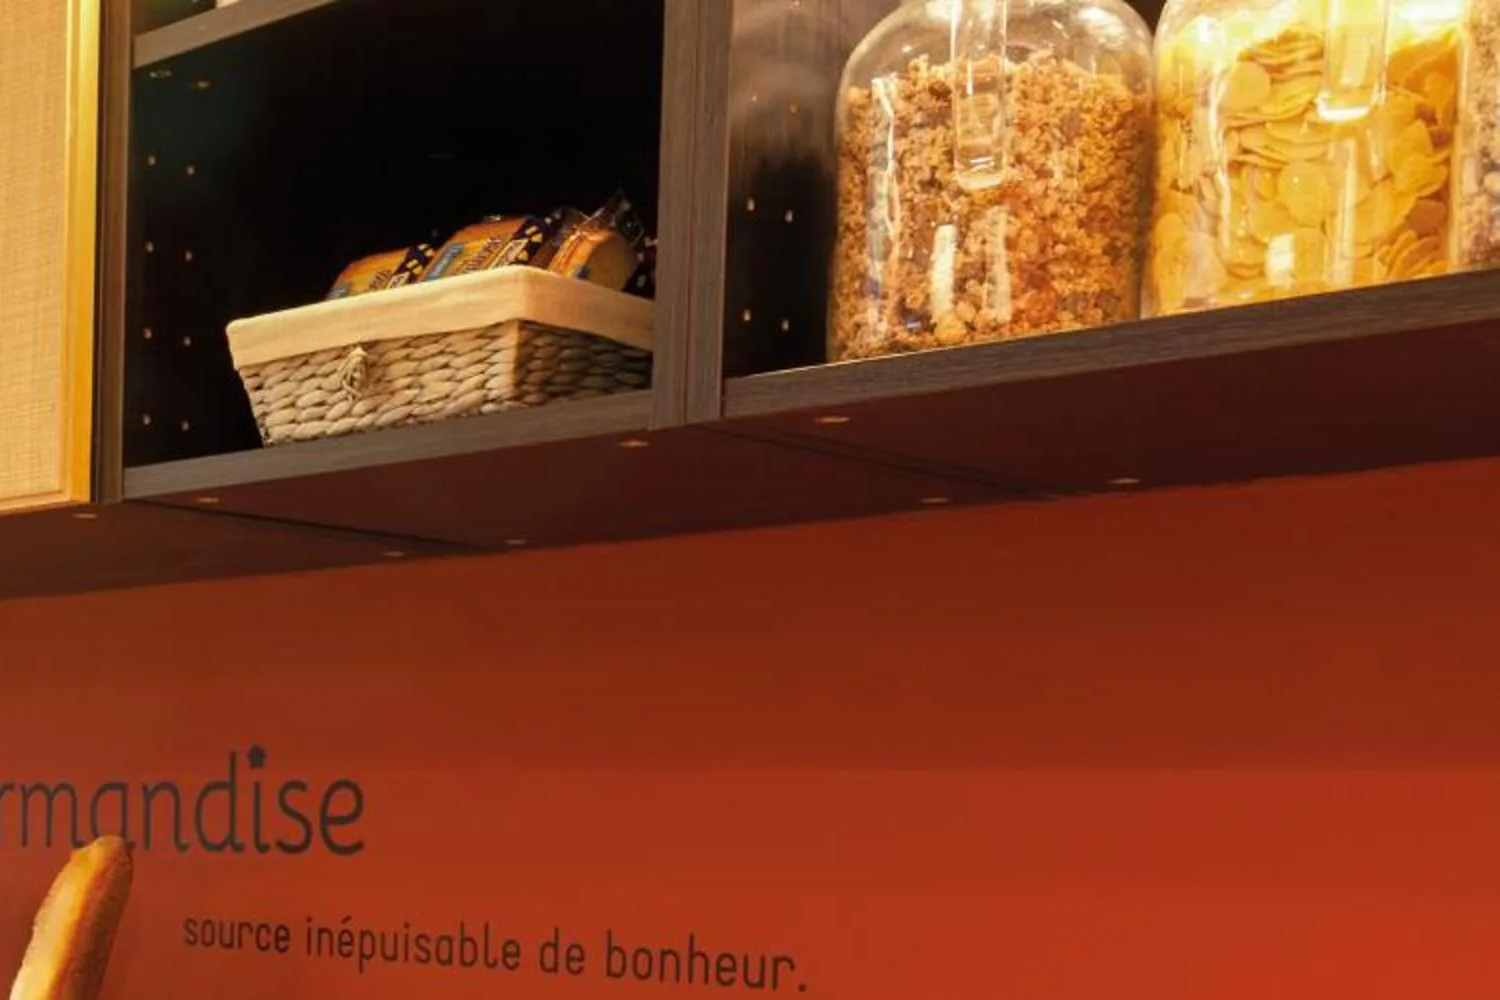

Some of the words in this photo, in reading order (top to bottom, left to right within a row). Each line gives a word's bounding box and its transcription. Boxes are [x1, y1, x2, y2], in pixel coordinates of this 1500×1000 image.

[183, 917, 290, 953] source
[306, 916, 521, 975] inépuisable
[539, 926, 586, 977] de
[606, 930, 807, 993] bonheur.
